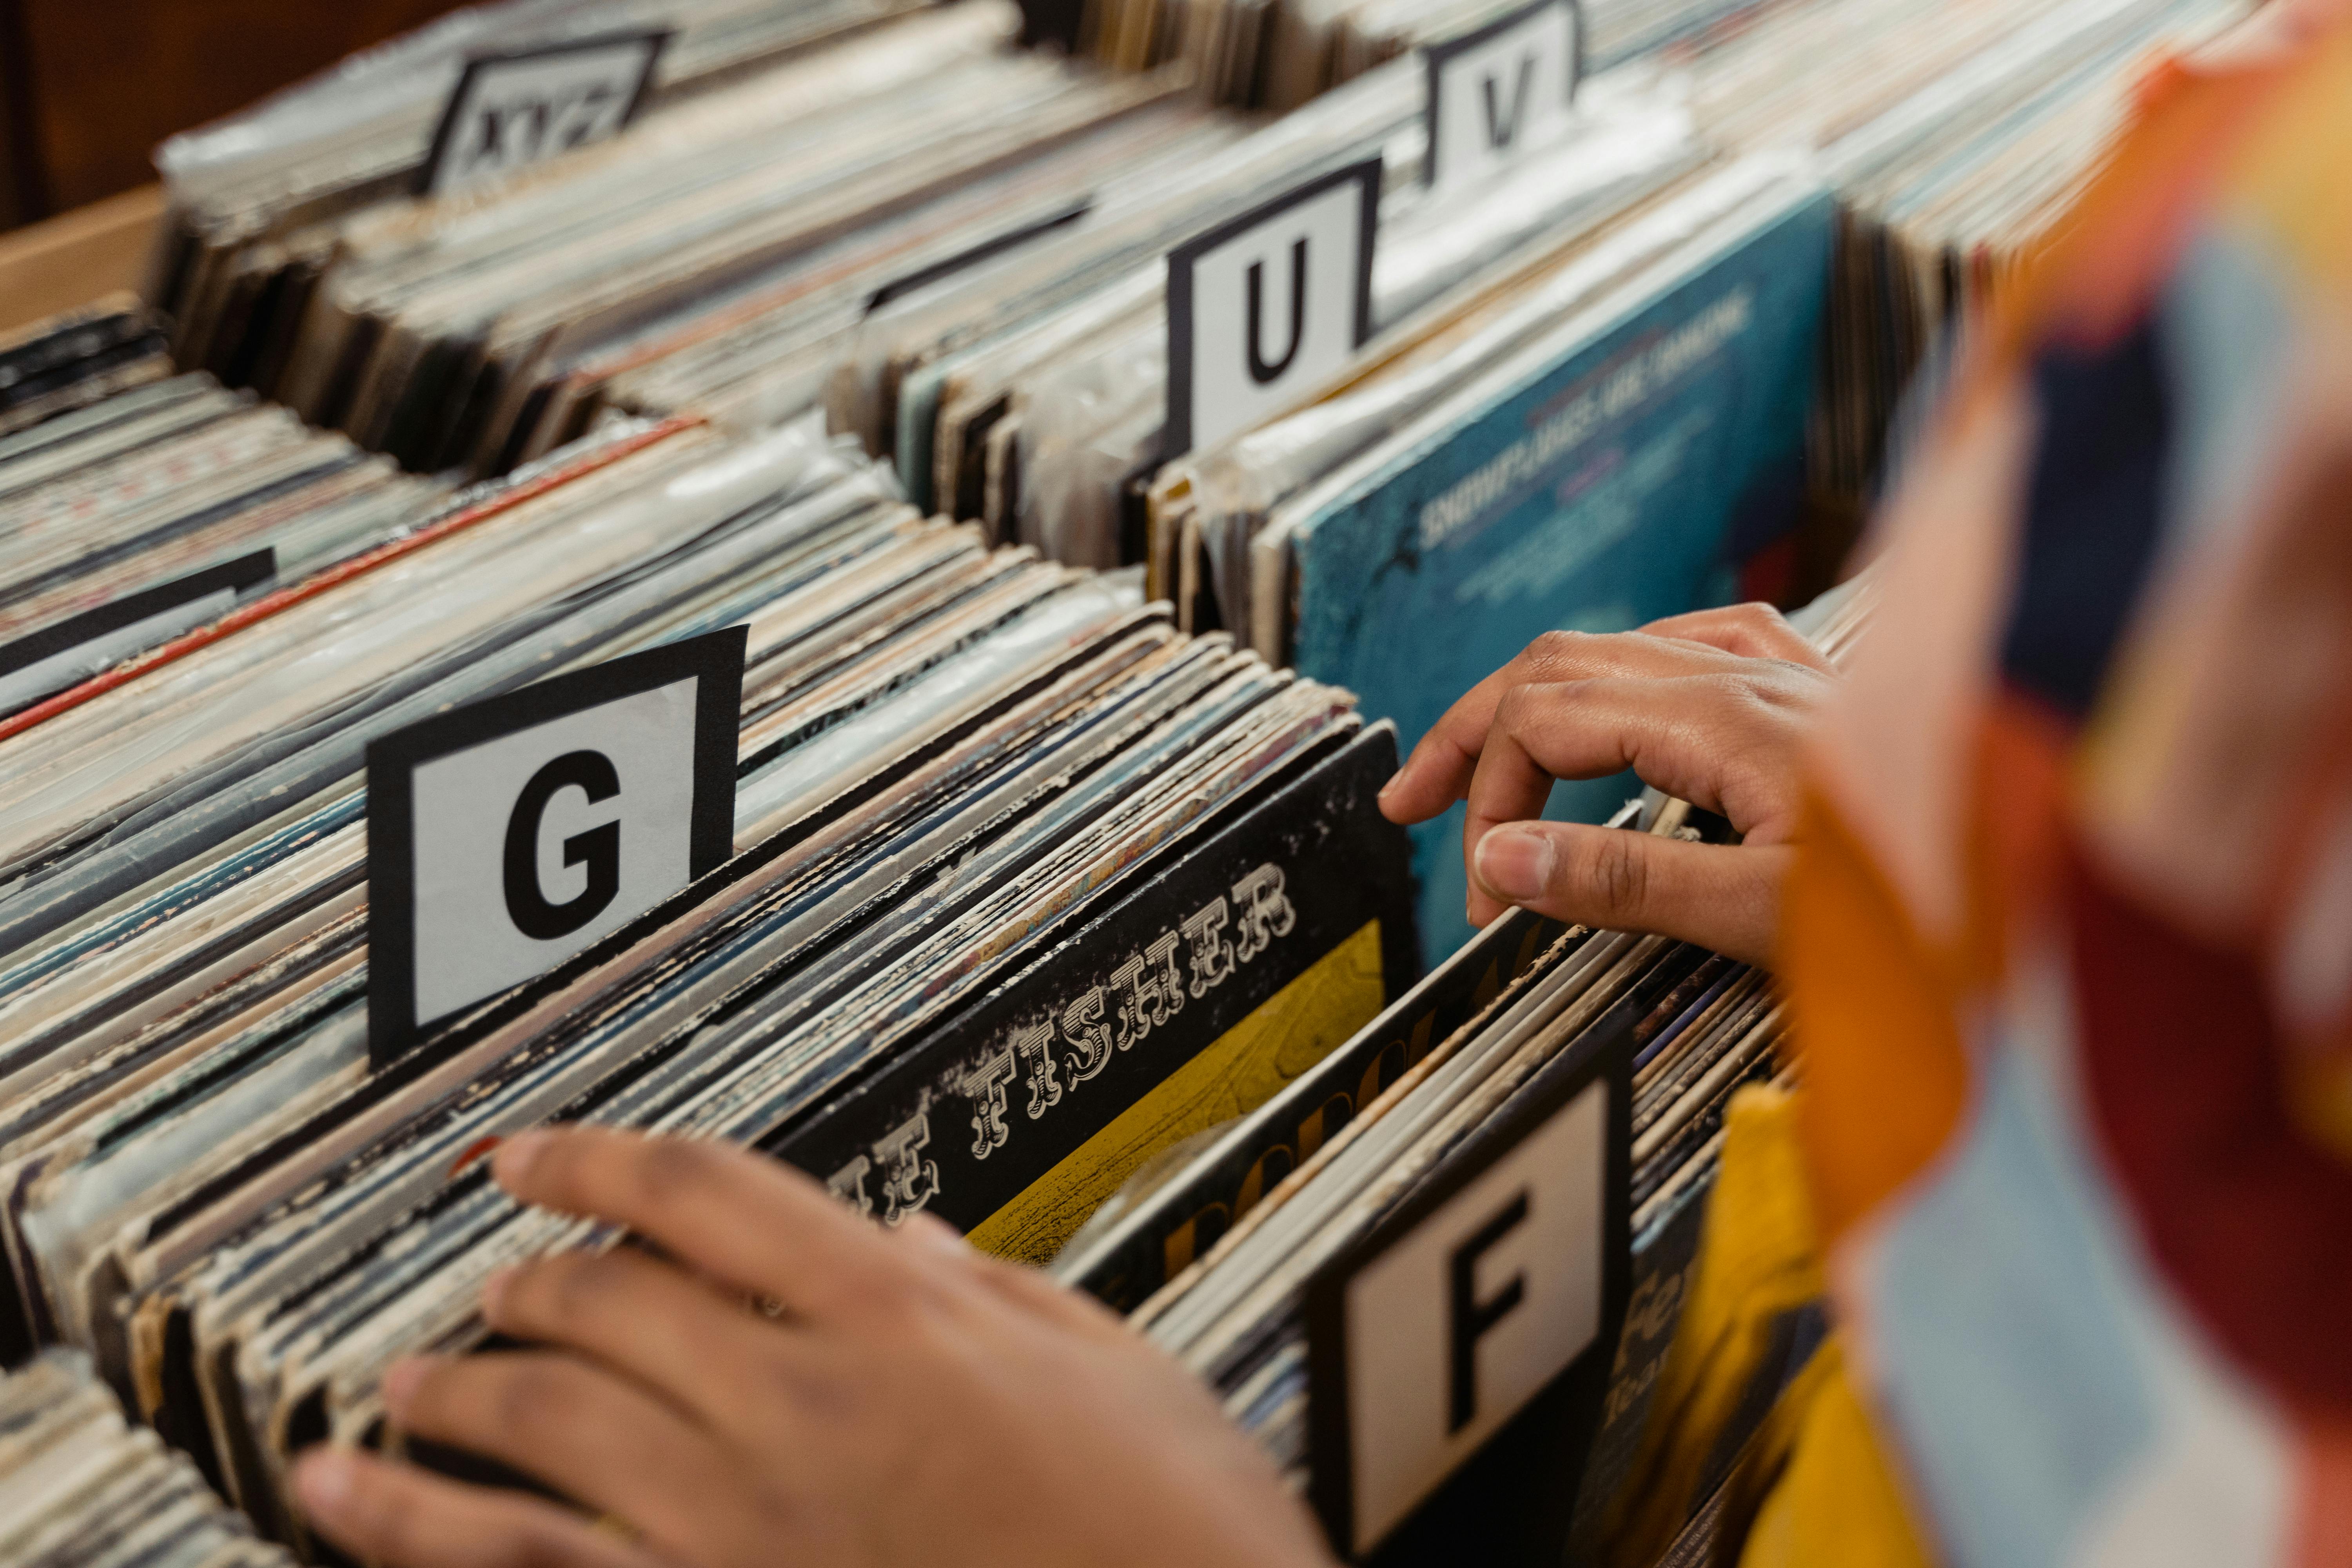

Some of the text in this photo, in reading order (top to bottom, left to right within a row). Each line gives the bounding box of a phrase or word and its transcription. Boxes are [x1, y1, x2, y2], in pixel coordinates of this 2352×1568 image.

[1479, 55, 1535, 152] V
[1246, 238, 1307, 385] U
[503, 749, 620, 940] G
[964, 862, 1296, 1160] FISHER
[1448, 1187, 1529, 1436] F
